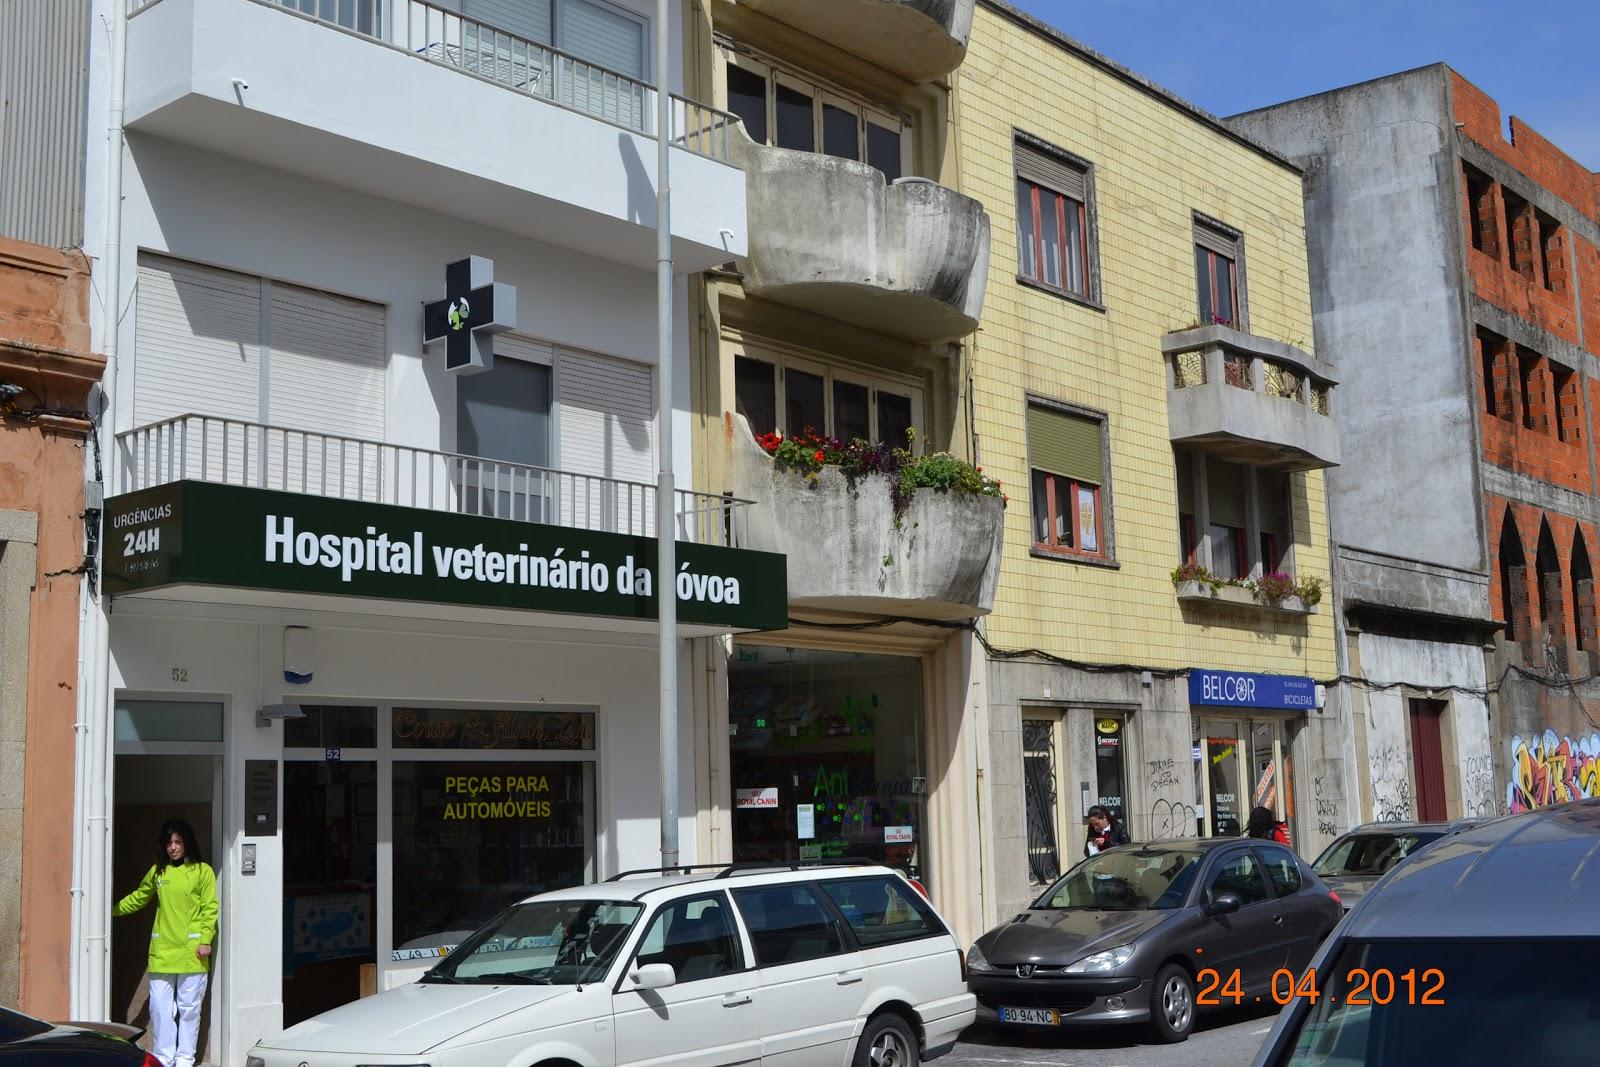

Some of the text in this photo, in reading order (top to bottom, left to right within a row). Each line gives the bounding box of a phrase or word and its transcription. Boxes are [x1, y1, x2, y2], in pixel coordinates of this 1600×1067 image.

[113, 504, 172, 529] URGÊNCIAS
[123, 527, 160, 557] 24H
[265, 514, 741, 605] Hospital veterinário da óvoa
[171, 668, 188, 682] 52
[1203, 675, 1256, 702] BELCOR
[1284, 694, 1312, 705] BICICLETAS
[326, 749, 340, 760] 52
[445, 776, 549, 798] PEÇAS PARA
[443, 797, 551, 820] AUTOMÓVEIS
[1004, 1008, 1053, 1023] 80-94-NC
